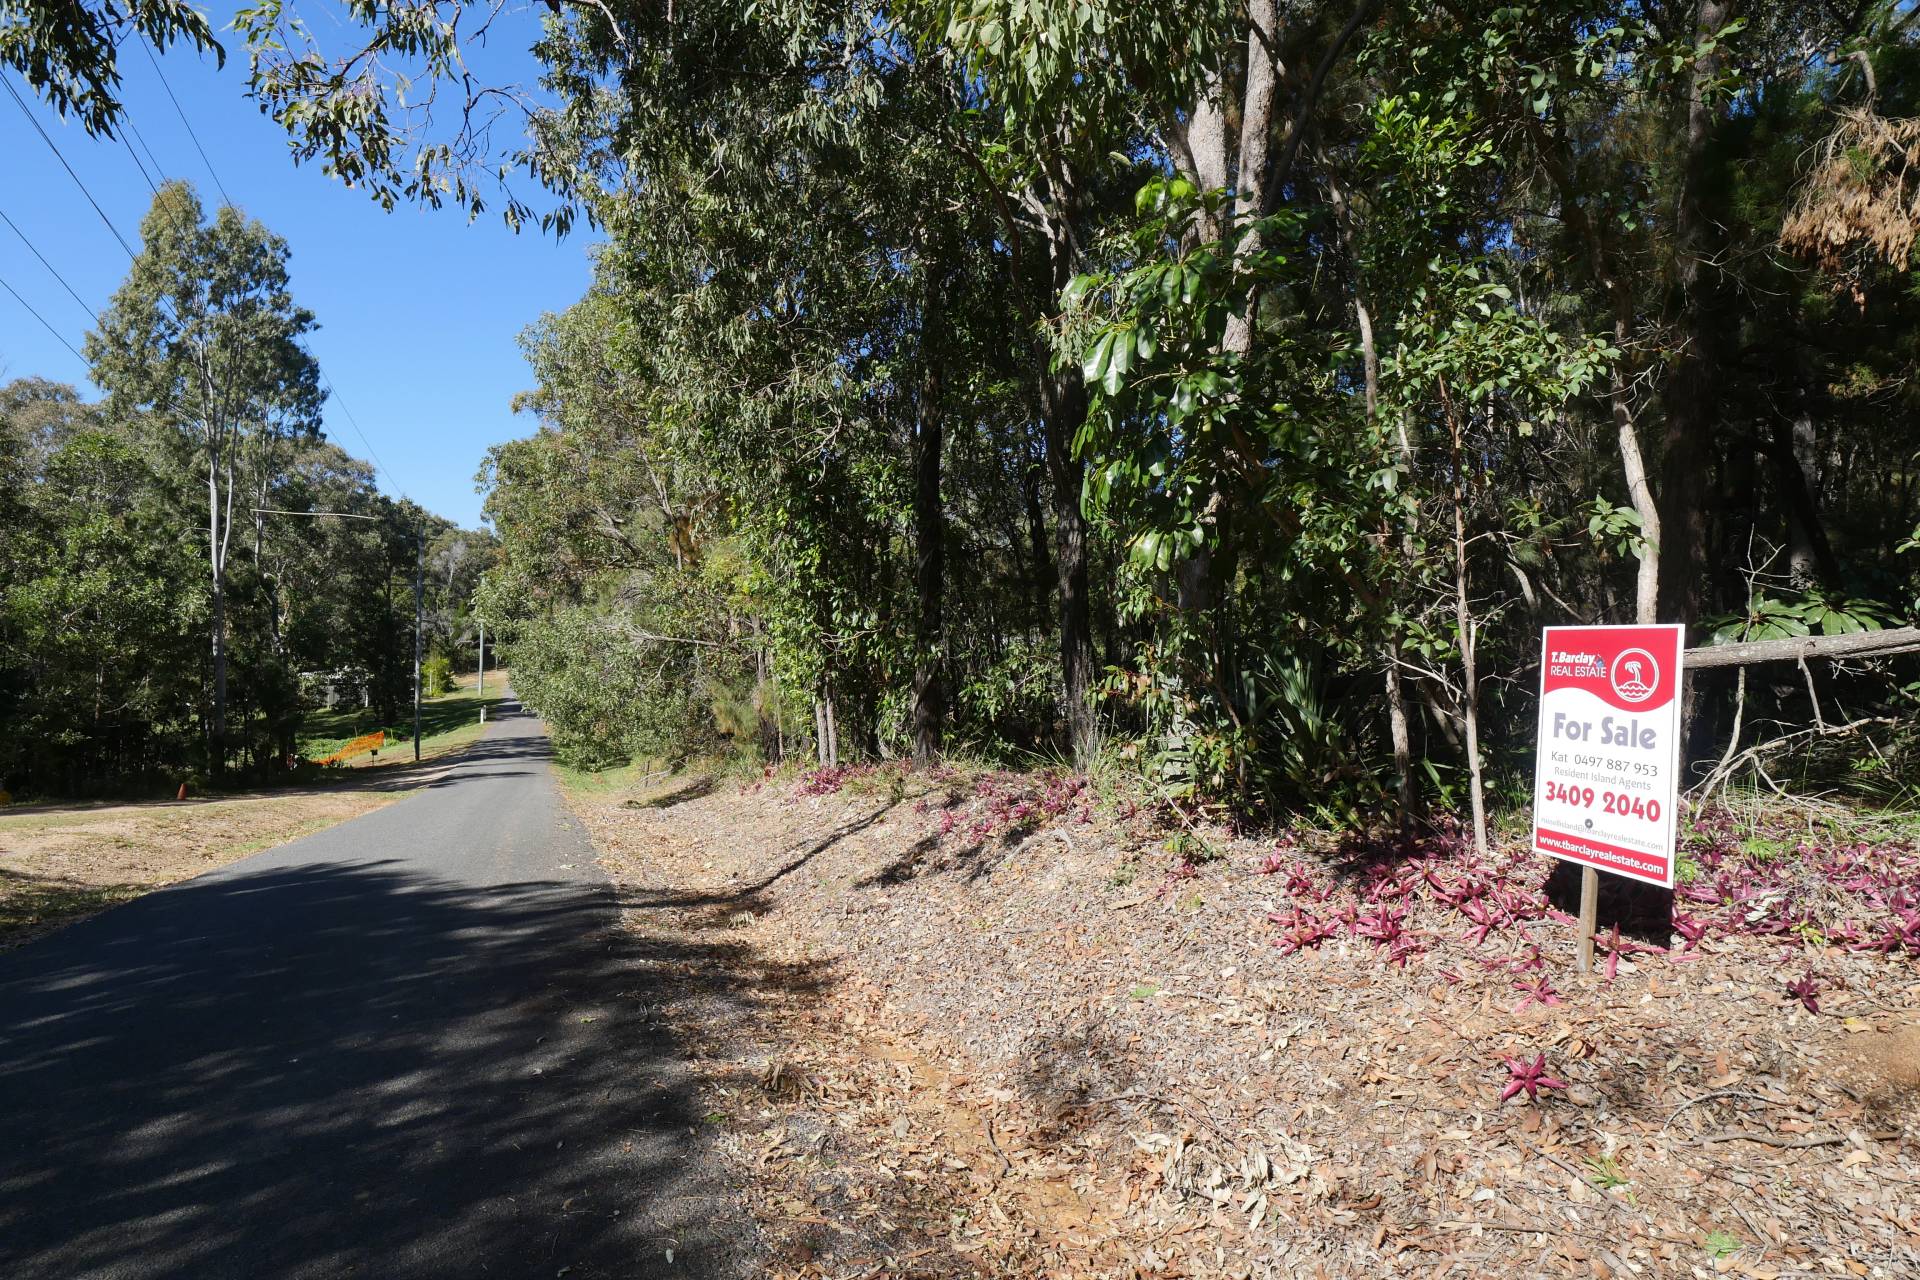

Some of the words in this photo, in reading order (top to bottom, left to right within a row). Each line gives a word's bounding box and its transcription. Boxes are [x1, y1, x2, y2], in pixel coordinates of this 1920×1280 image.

[1551, 666, 1573, 677] REAL
[1575, 667, 1606, 678] ESTATE
[1553, 712, 1592, 742] For
[1601, 716, 1657, 750] Sale
[1551, 751, 1568, 763] Kat
[1574, 754, 1603, 768] 0497
[1606, 759, 1630, 772] 887
[1633, 763, 1658, 777] 953
[1554, 766, 1589, 780] Resident
[1591, 770, 1617, 783] Island
[1618, 775, 1652, 791] Agents
[1545, 781, 1595, 808] 3409
[1602, 791, 1661, 823] 2040
[1539, 834, 1664, 875] www.tbarclayrealestate.com
